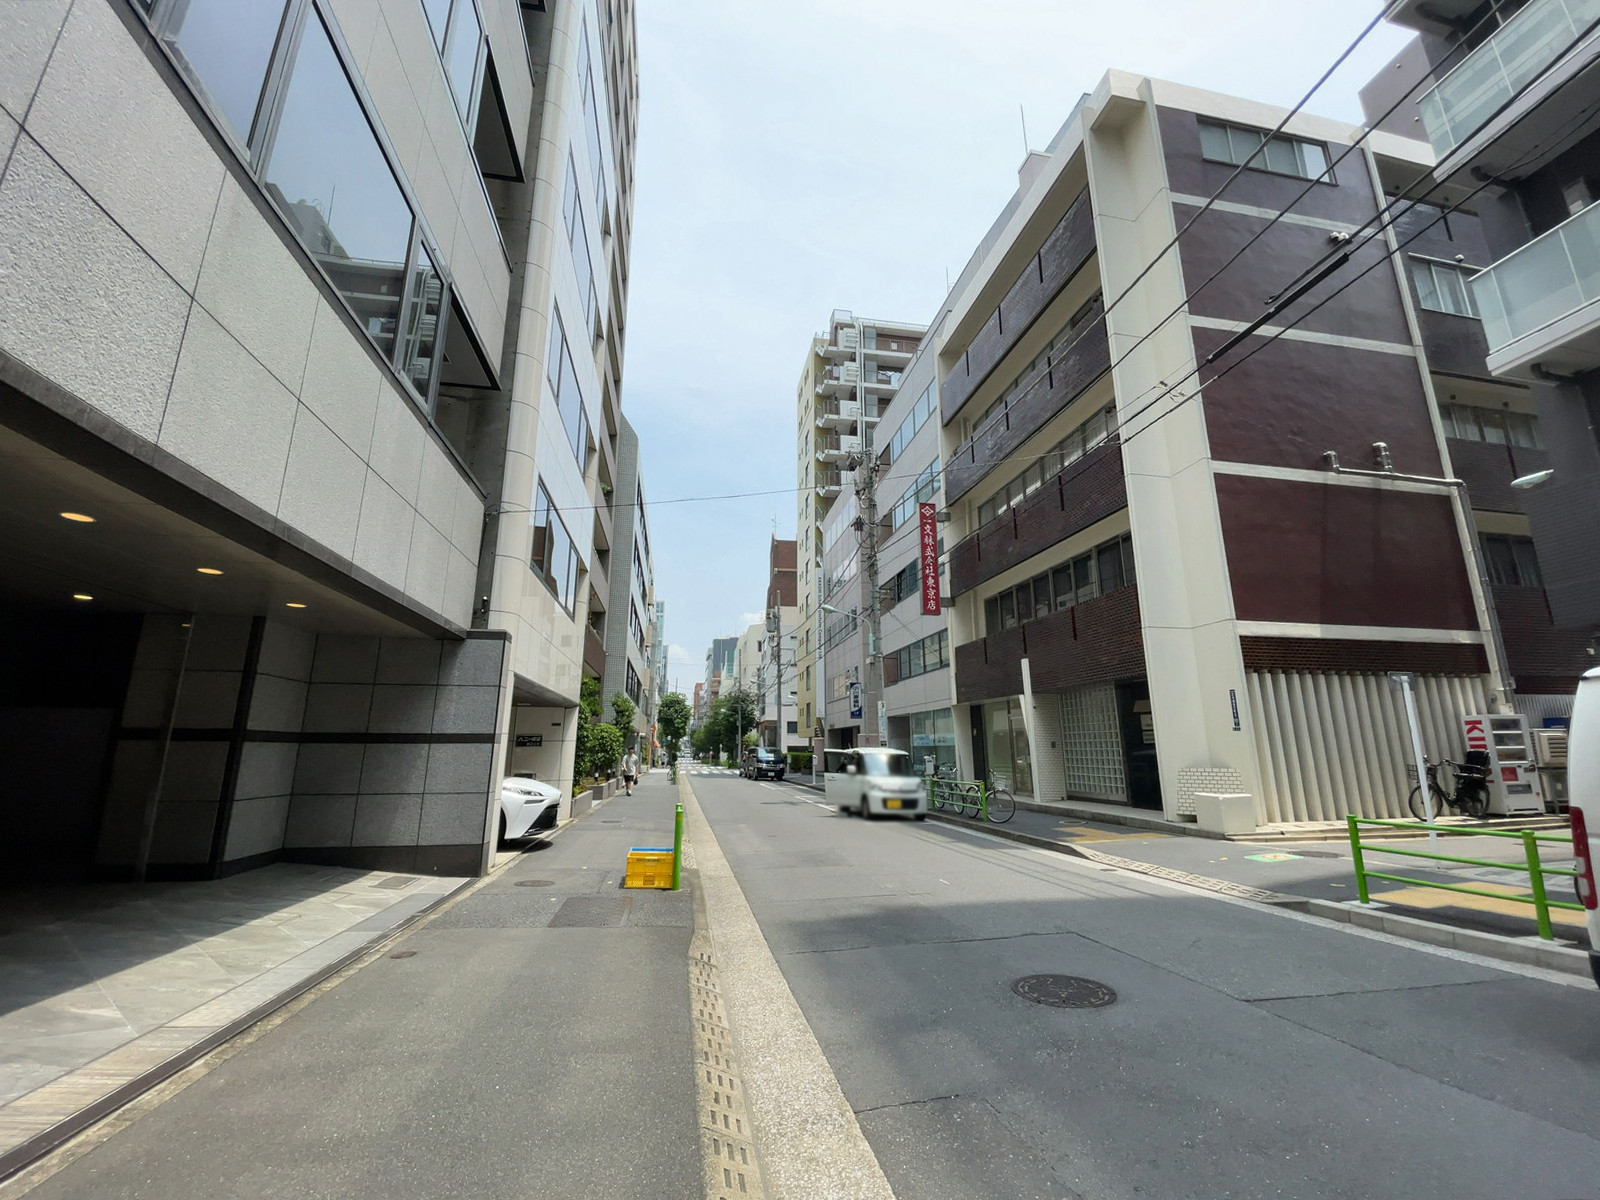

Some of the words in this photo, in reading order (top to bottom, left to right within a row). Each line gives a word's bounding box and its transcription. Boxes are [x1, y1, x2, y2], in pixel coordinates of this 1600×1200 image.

[922, 519, 936, 610] 一文株式会社東京店
